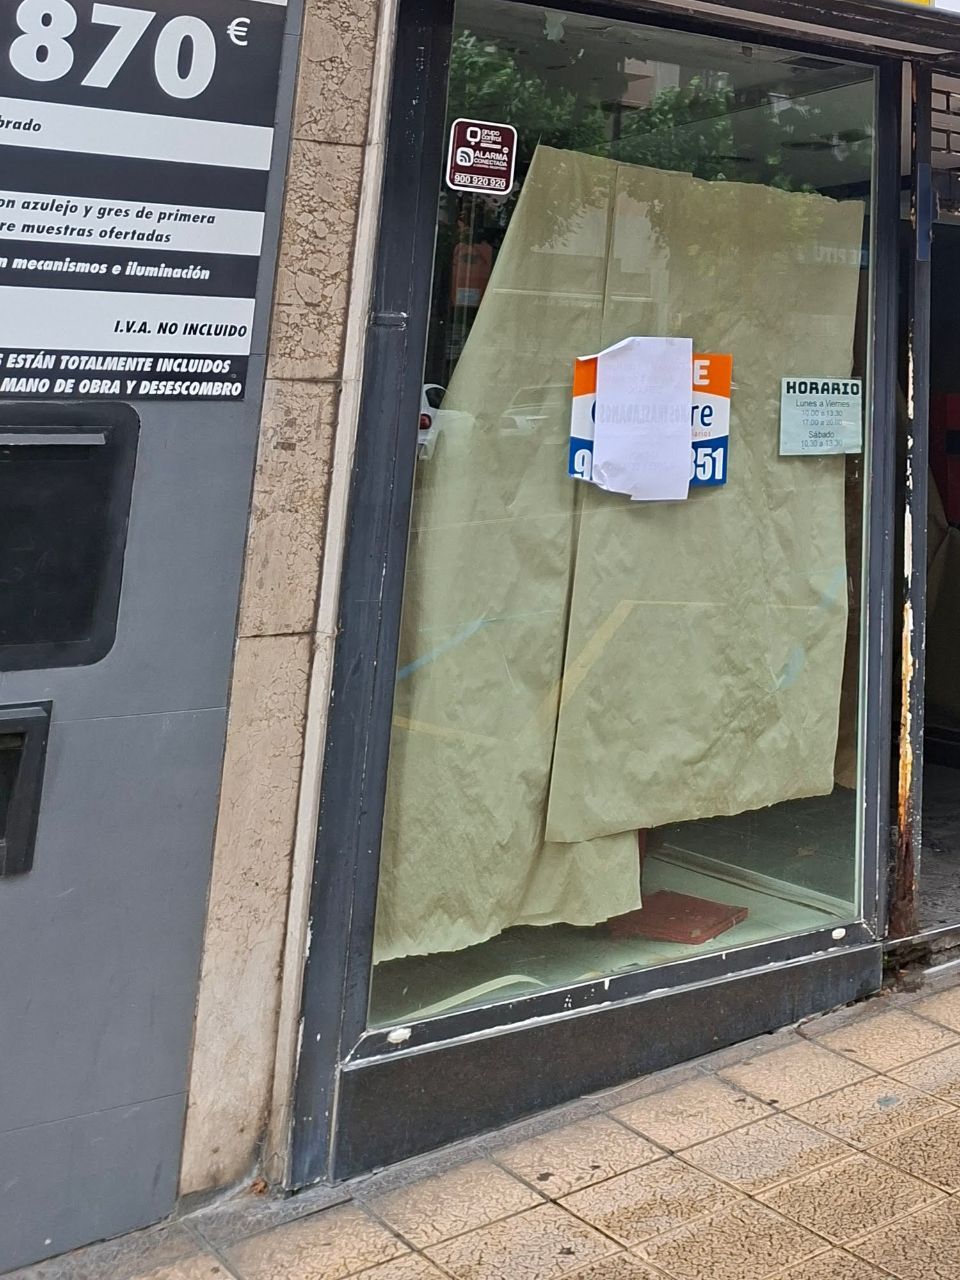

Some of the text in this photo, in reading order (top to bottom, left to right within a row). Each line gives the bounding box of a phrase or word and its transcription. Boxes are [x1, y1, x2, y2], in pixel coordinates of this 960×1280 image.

[473, 158, 508, 167] CONECTADA
[474, 150, 508, 161] ALARMA
[454, 174, 506, 188] 900 920 920
[21, 198, 78, 216] azulejo
[83, 205, 93, 217] y
[97, 206, 130, 219] gres
[135, 206, 153, 219] de
[157, 209, 216, 224] primera
[21, 223, 94, 238] muestras
[99, 226, 171, 243] ofertadas
[12, 257, 108, 274] mecanismos
[111, 264, 122, 275] e
[125, 261, 210, 280] iluminación
[113, 320, 247, 337] I.V.A. NO INCLUIDO
[6, 351, 56, 369] ESTÁN
[60, 355, 153, 371] TOTALMENTE
[156, 358, 231, 374] INCLUIDOS
[1, 377, 242, 396] MANO DE OBRA Y DESESCOMBRO
[786, 381, 860, 395] HORARIO
[795, 399, 818, 408] Lunes
[825, 399, 850, 408] Viernes
[808, 430, 835, 439] Sábado
